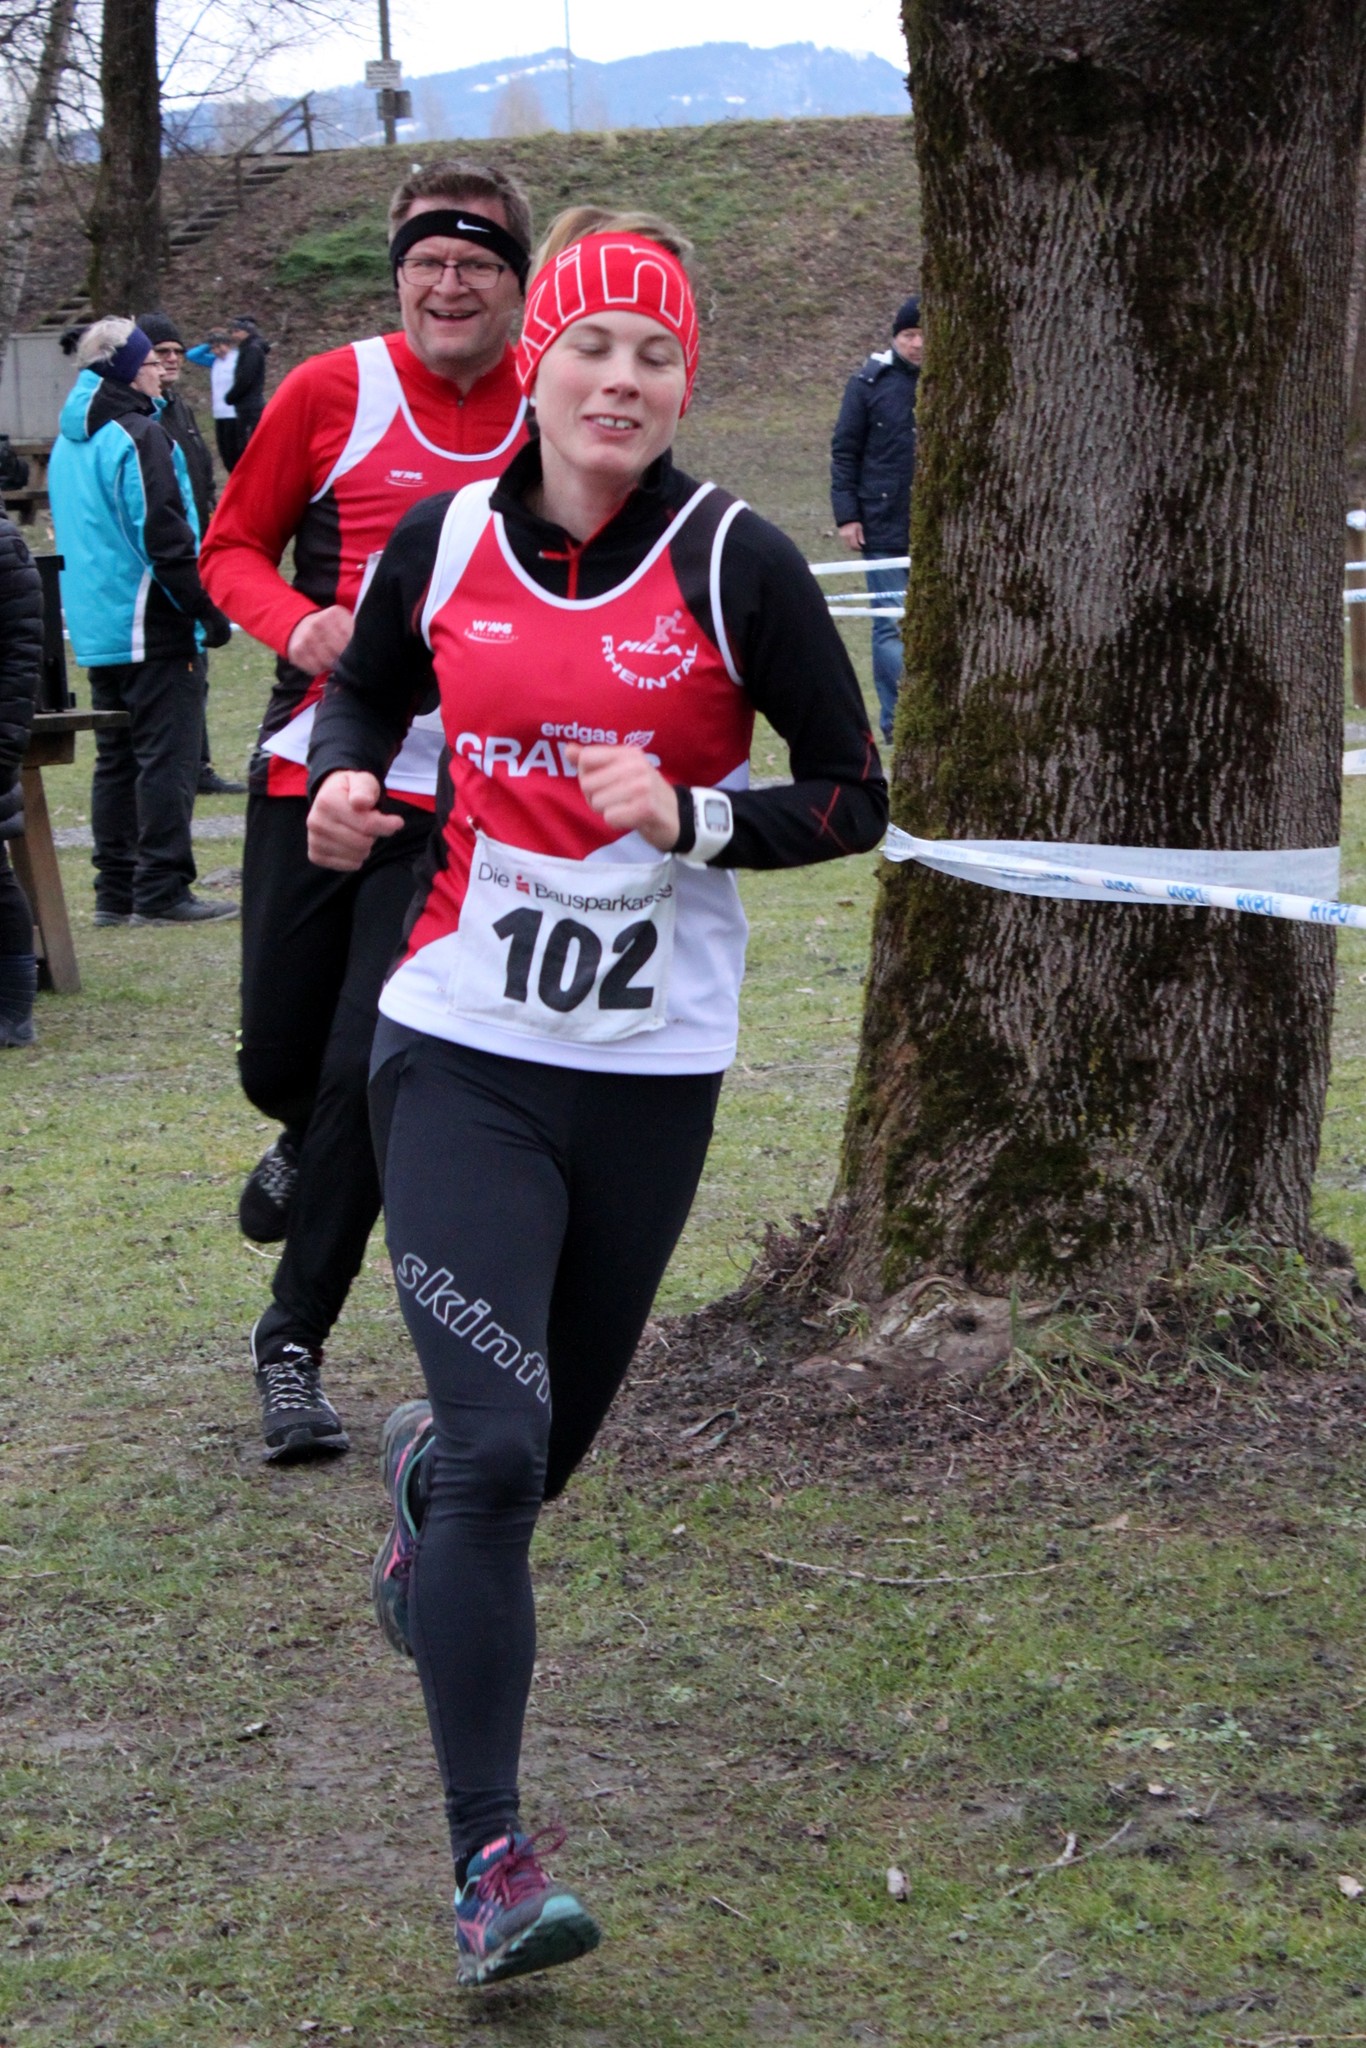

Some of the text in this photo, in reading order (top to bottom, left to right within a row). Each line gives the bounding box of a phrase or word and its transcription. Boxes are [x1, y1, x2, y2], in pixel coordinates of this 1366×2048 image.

[602, 635, 698, 690] RHEINTAL
[617, 640, 682, 656] MILA
[541, 722, 618, 744] erdgas
[478, 862, 510, 888] Die
[492, 906, 658, 1013] 102
[397, 1253, 550, 1404] skinfi
